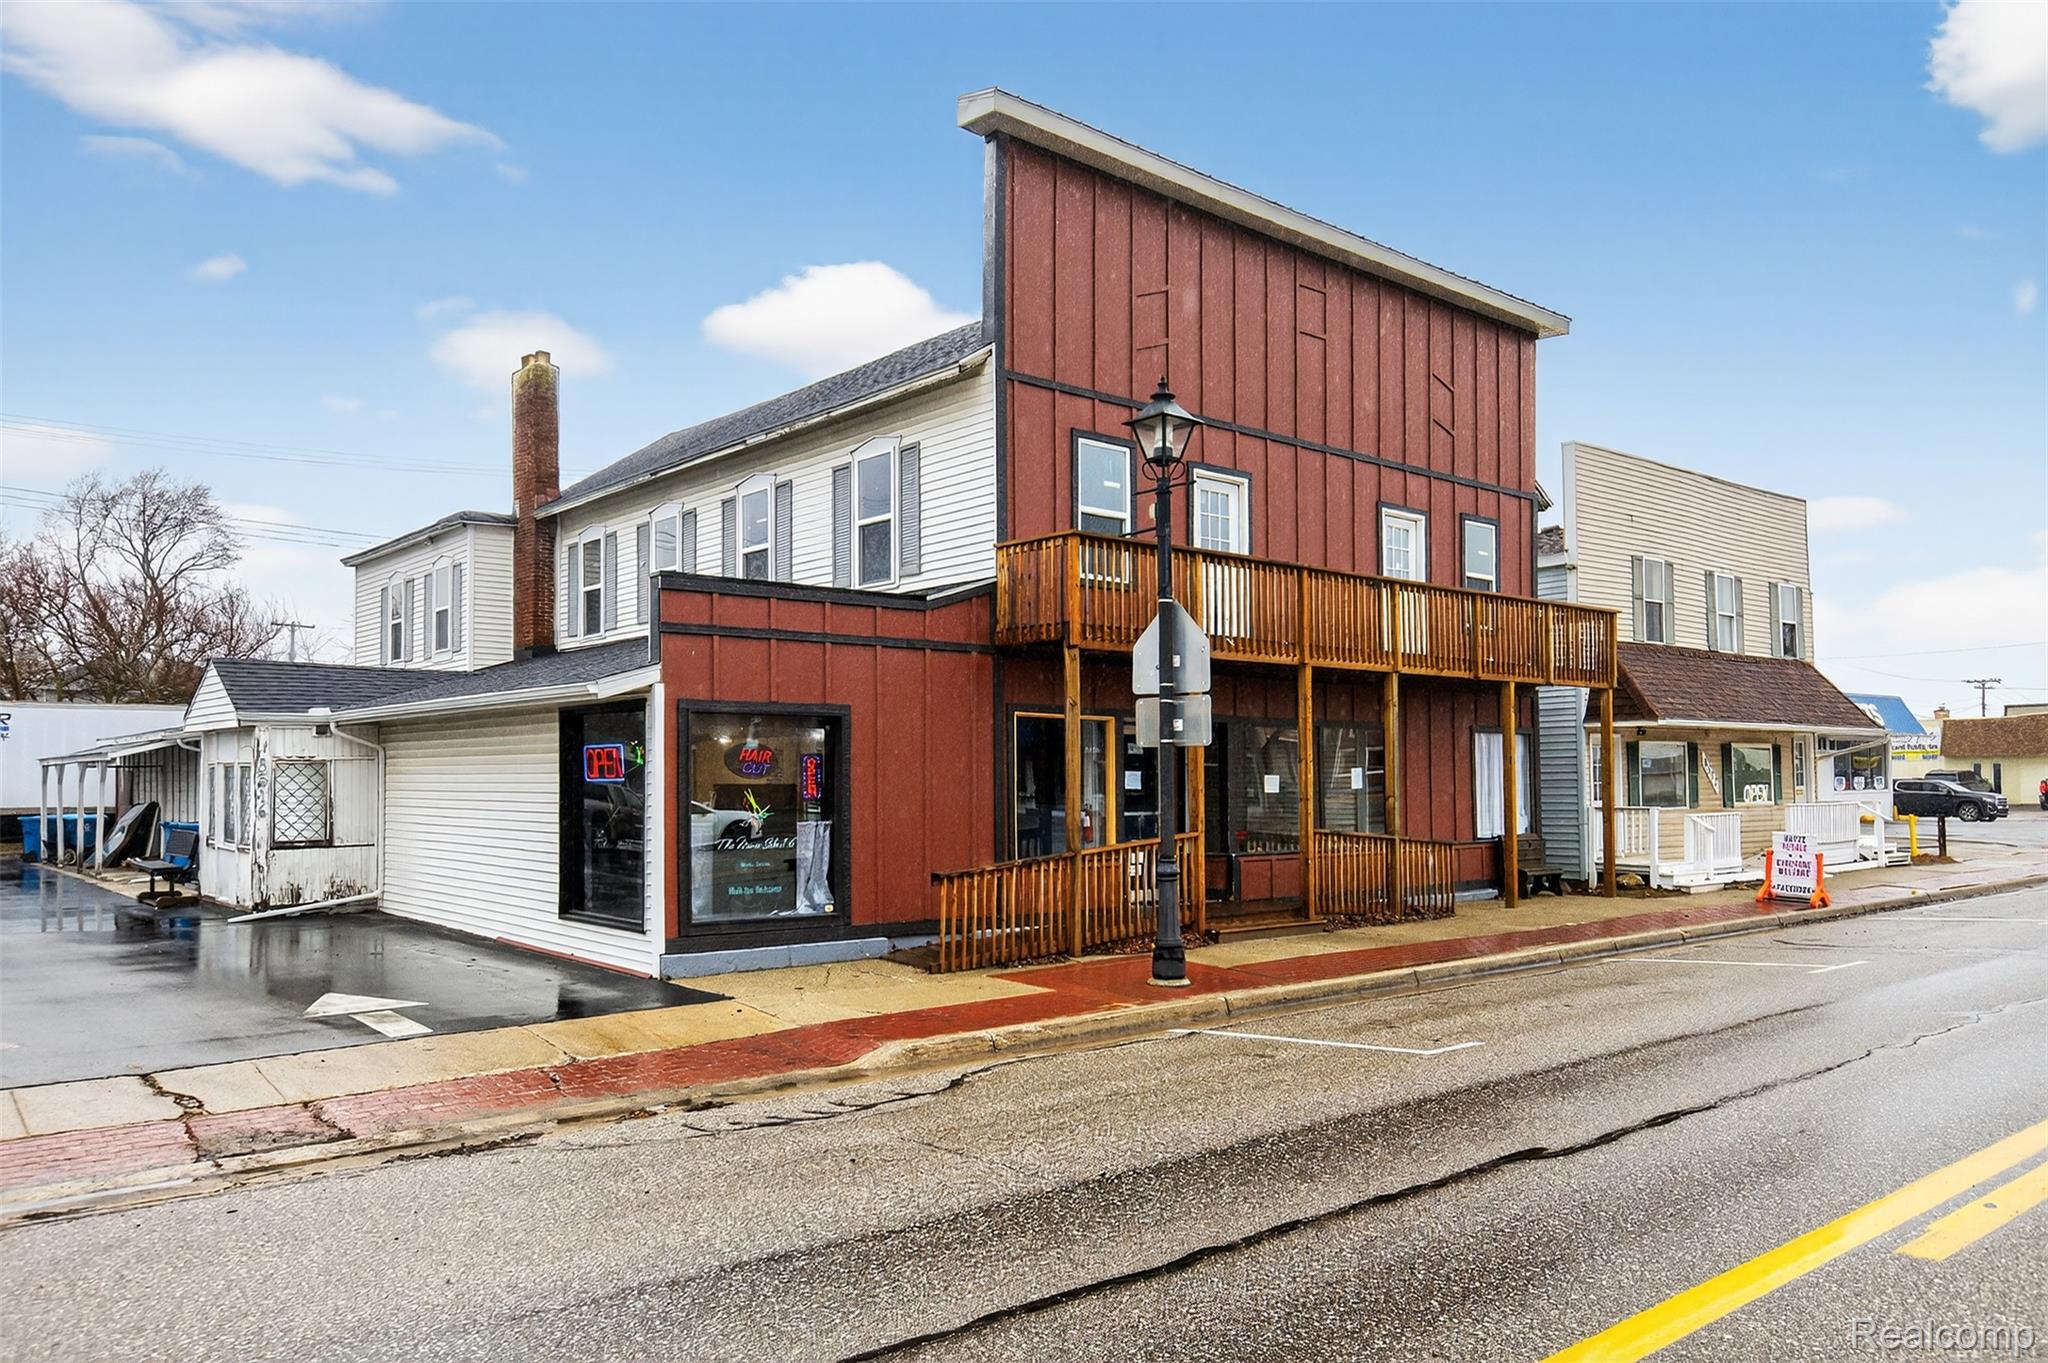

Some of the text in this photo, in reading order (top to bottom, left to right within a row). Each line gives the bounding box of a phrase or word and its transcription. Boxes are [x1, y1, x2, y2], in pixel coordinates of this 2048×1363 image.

[586, 748, 624, 778] OPEN
[739, 747, 773, 763] HAIR
[742, 762, 772, 775] CUT
[1743, 784, 1769, 803] OPEN
